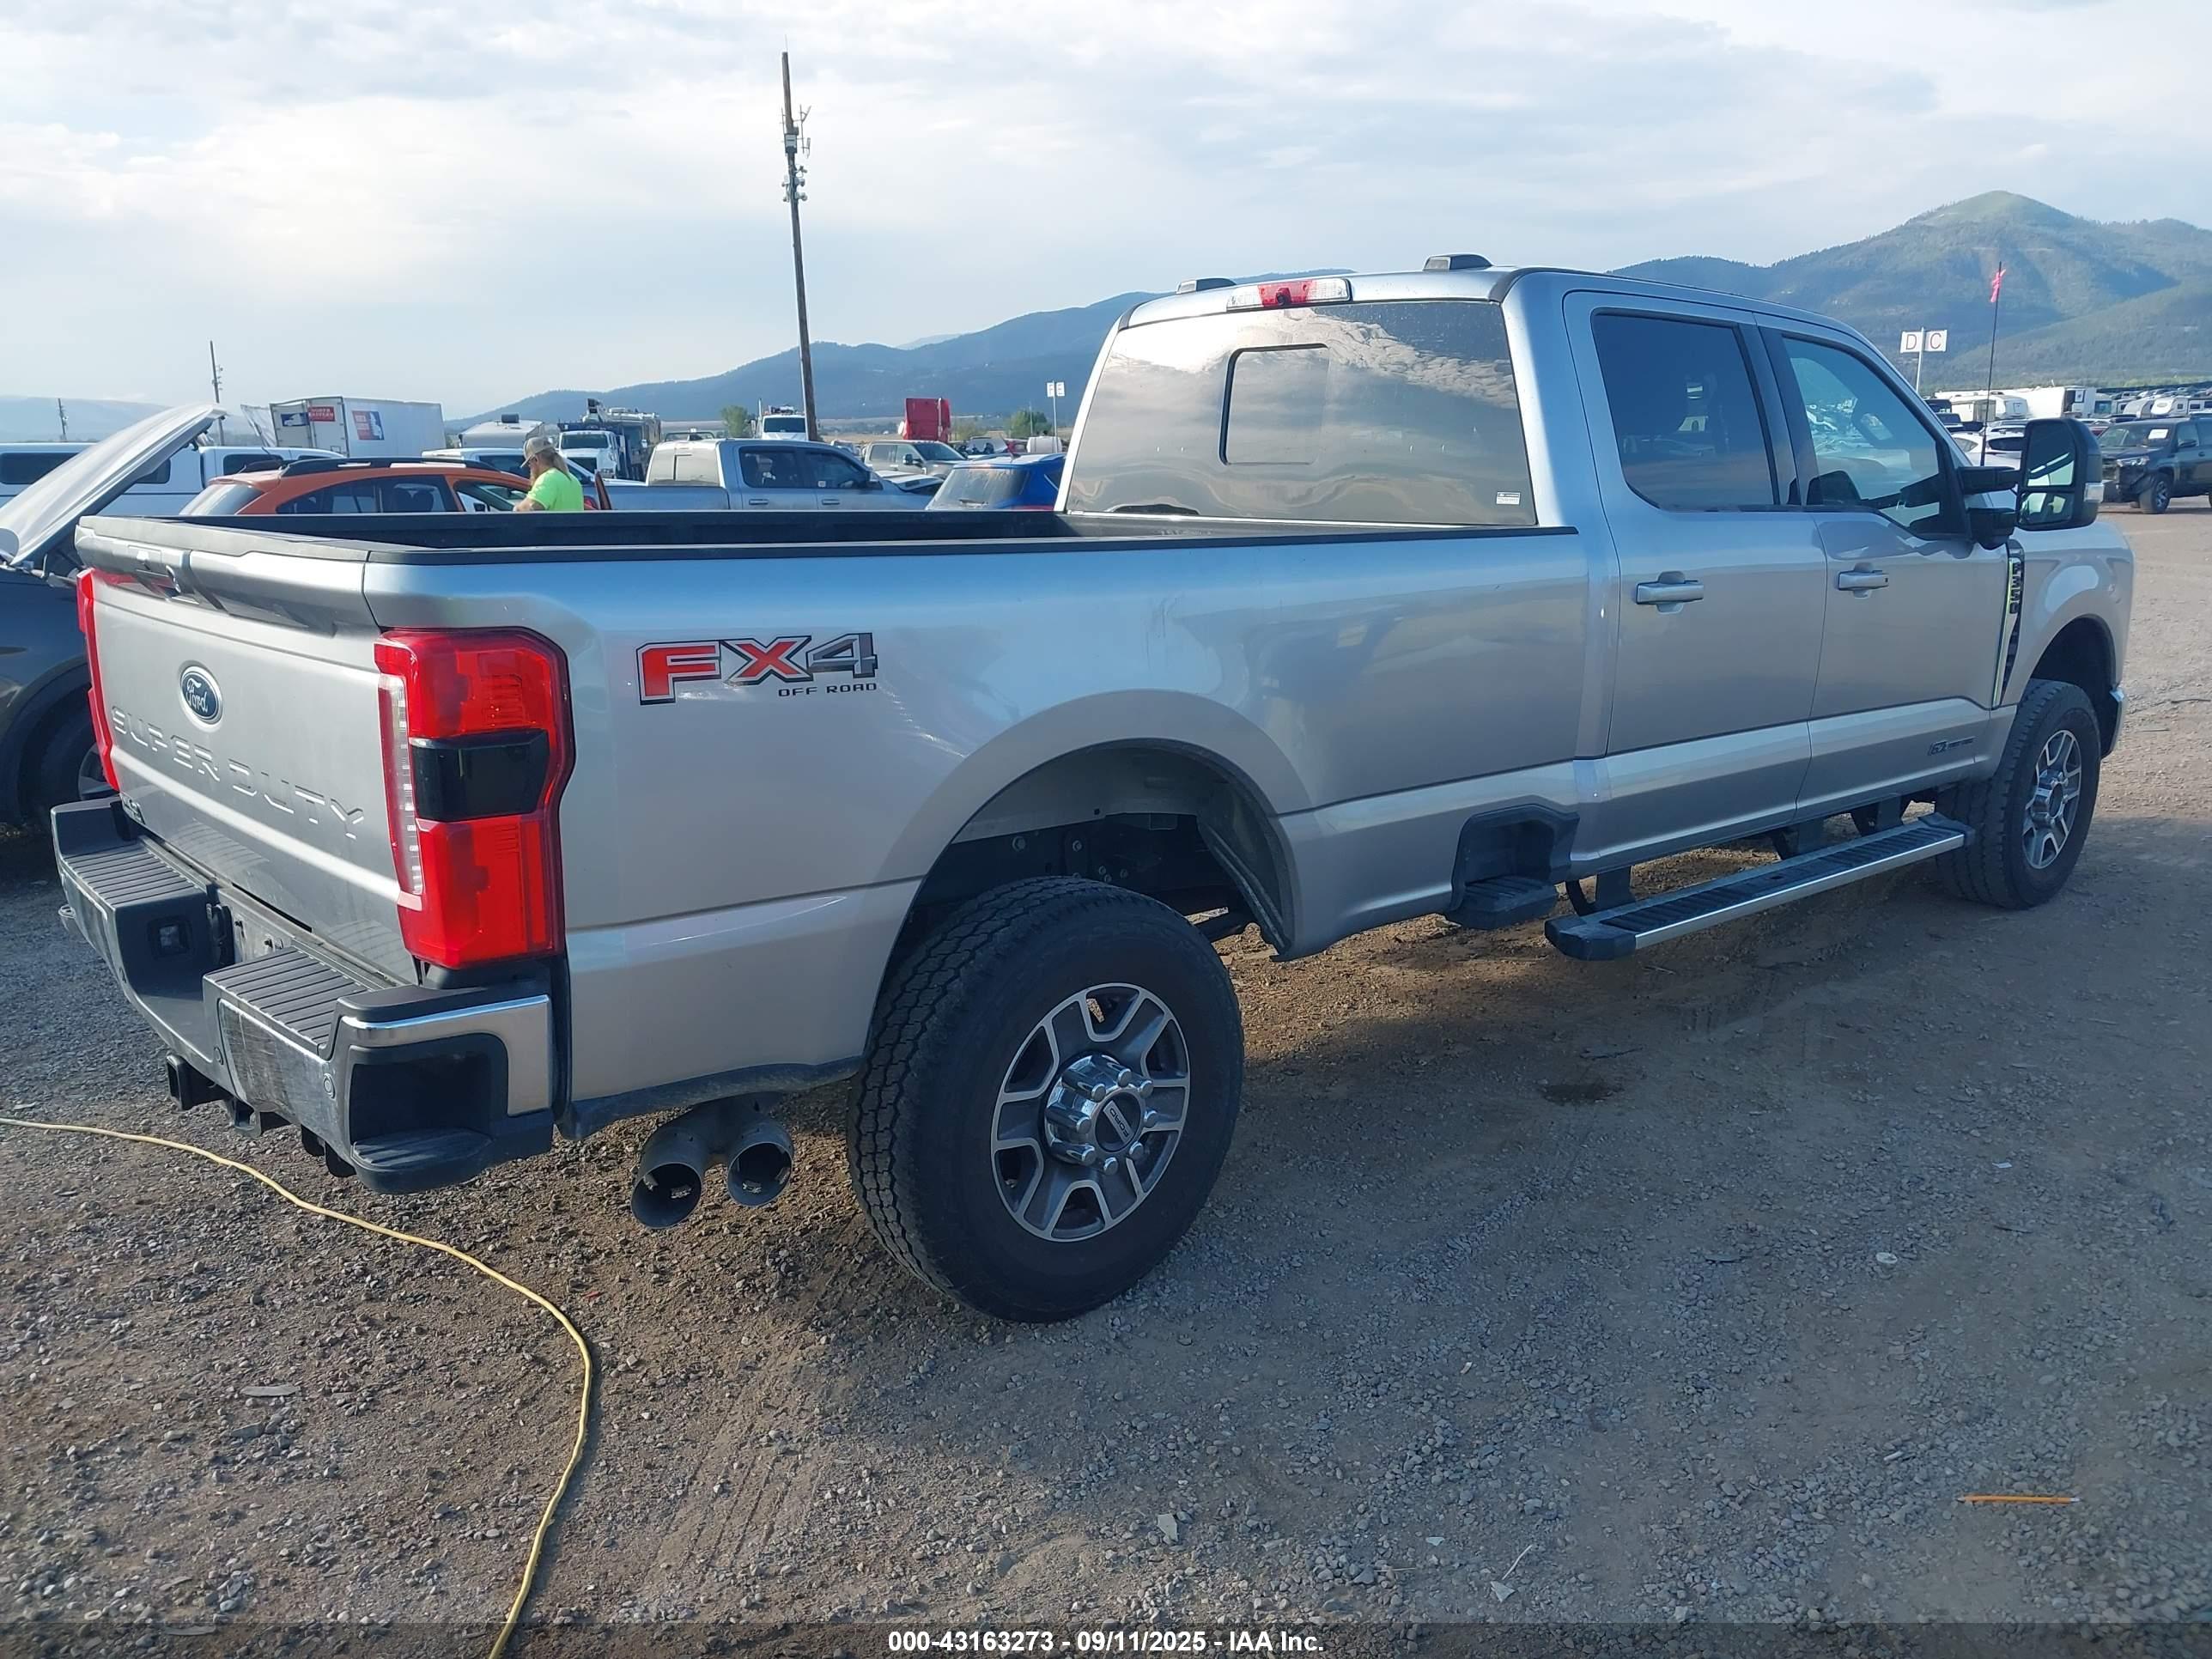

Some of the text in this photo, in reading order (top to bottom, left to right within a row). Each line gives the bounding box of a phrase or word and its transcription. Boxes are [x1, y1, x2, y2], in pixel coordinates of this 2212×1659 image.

[1905, 333, 1917, 350] D
[1929, 332, 1942, 349] C
[635, 632, 878, 706] FX4
[185, 677, 210, 714] Ford
[777, 683, 878, 697] OFF ROAD
[112, 705, 365, 841] SUPER DUTY
[1109, 1107, 1129, 1138] FORD
